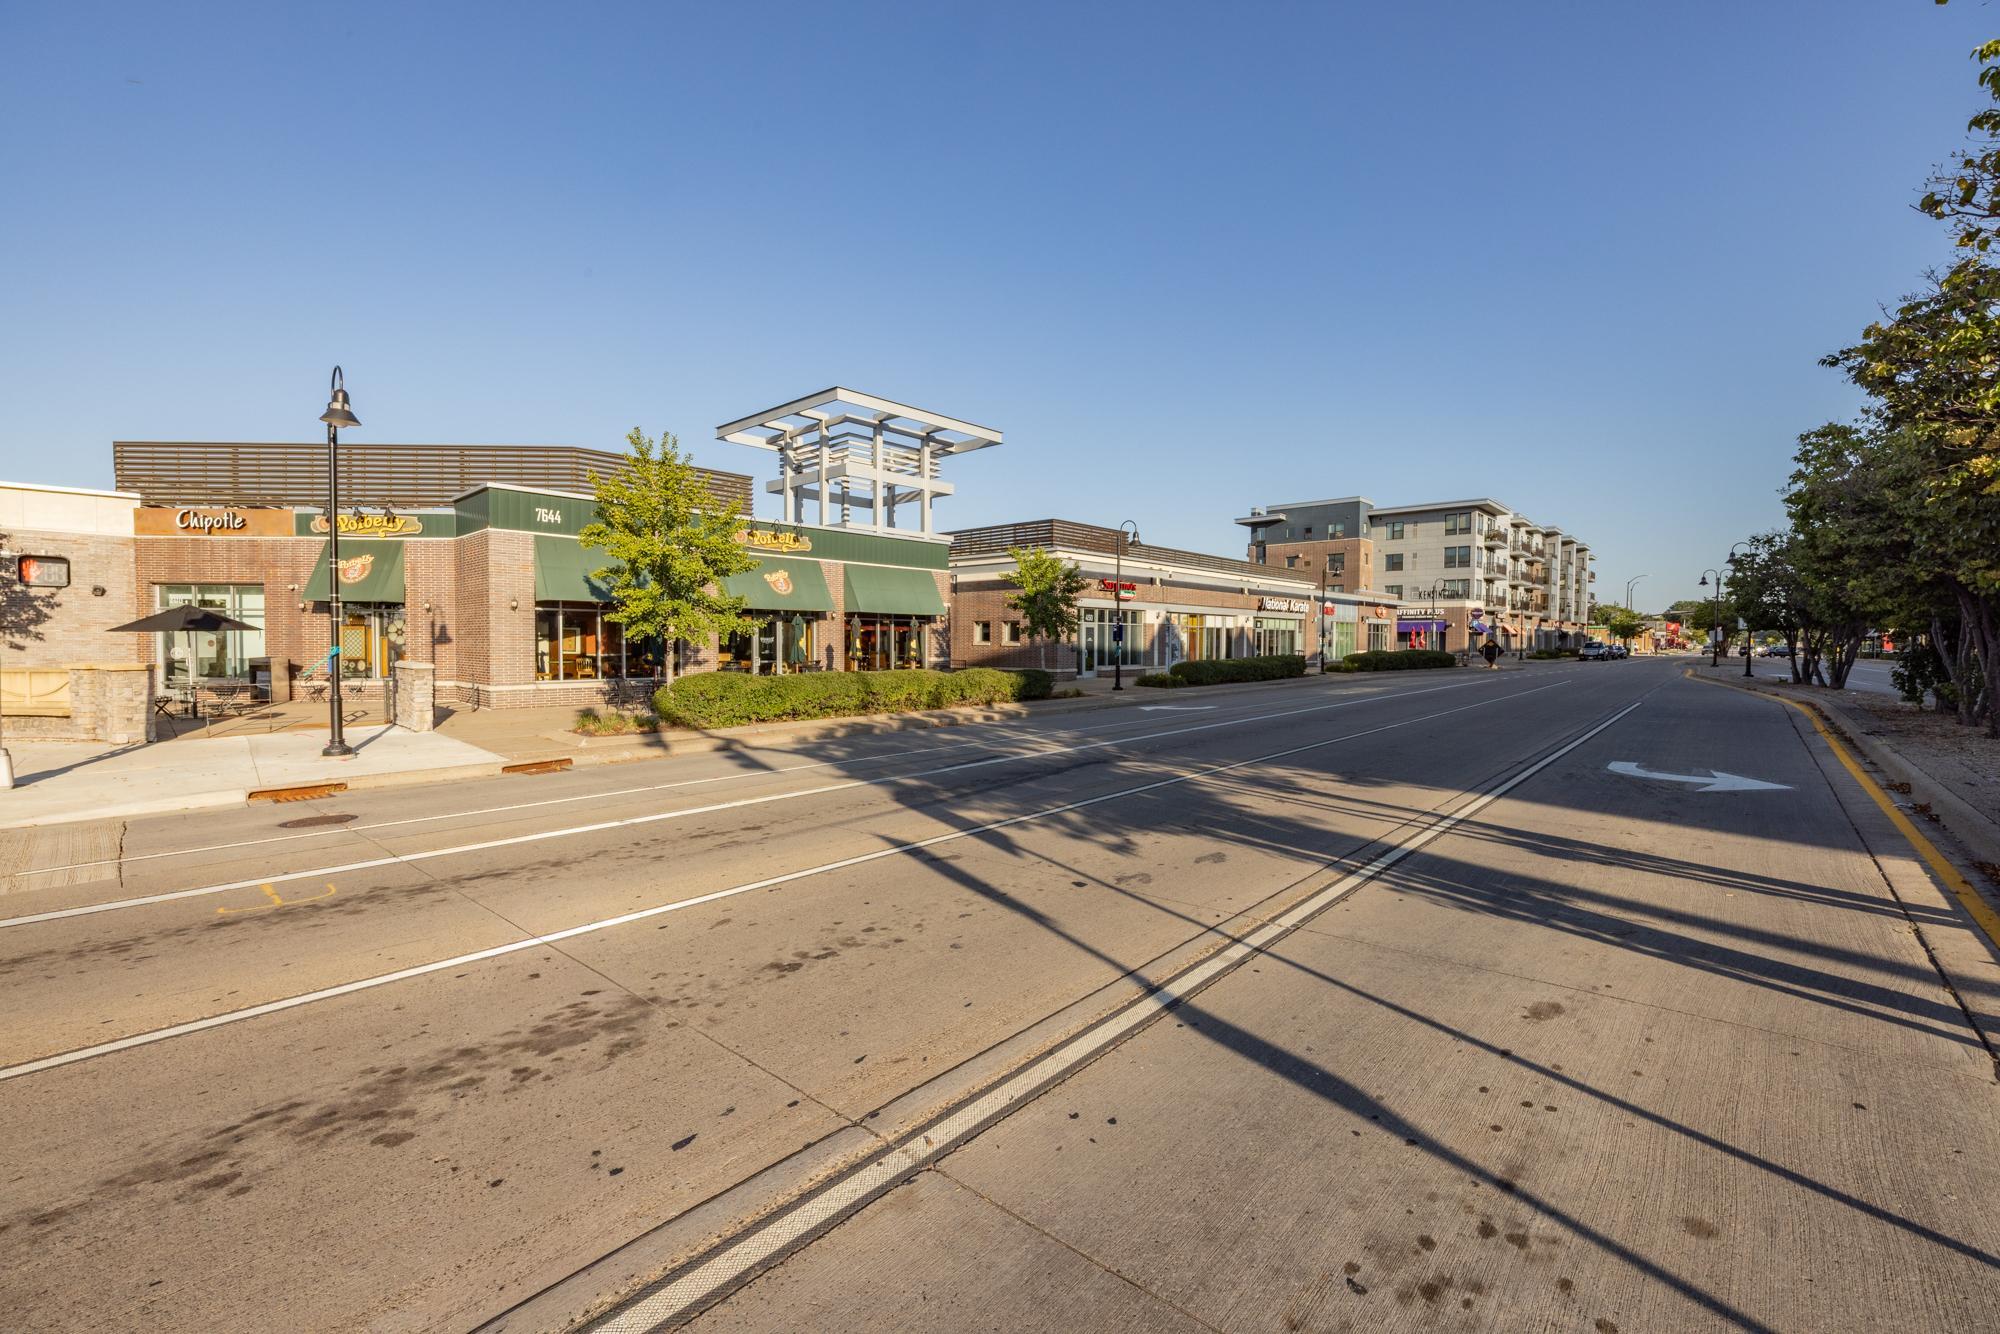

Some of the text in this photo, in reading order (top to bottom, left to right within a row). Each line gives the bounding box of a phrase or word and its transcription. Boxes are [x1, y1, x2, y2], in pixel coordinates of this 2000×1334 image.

[175, 509, 246, 534] Chipotle
[535, 507, 562, 524] 7644
[1262, 597, 1289, 611] National
[1290, 600, 1310, 613] Karate
